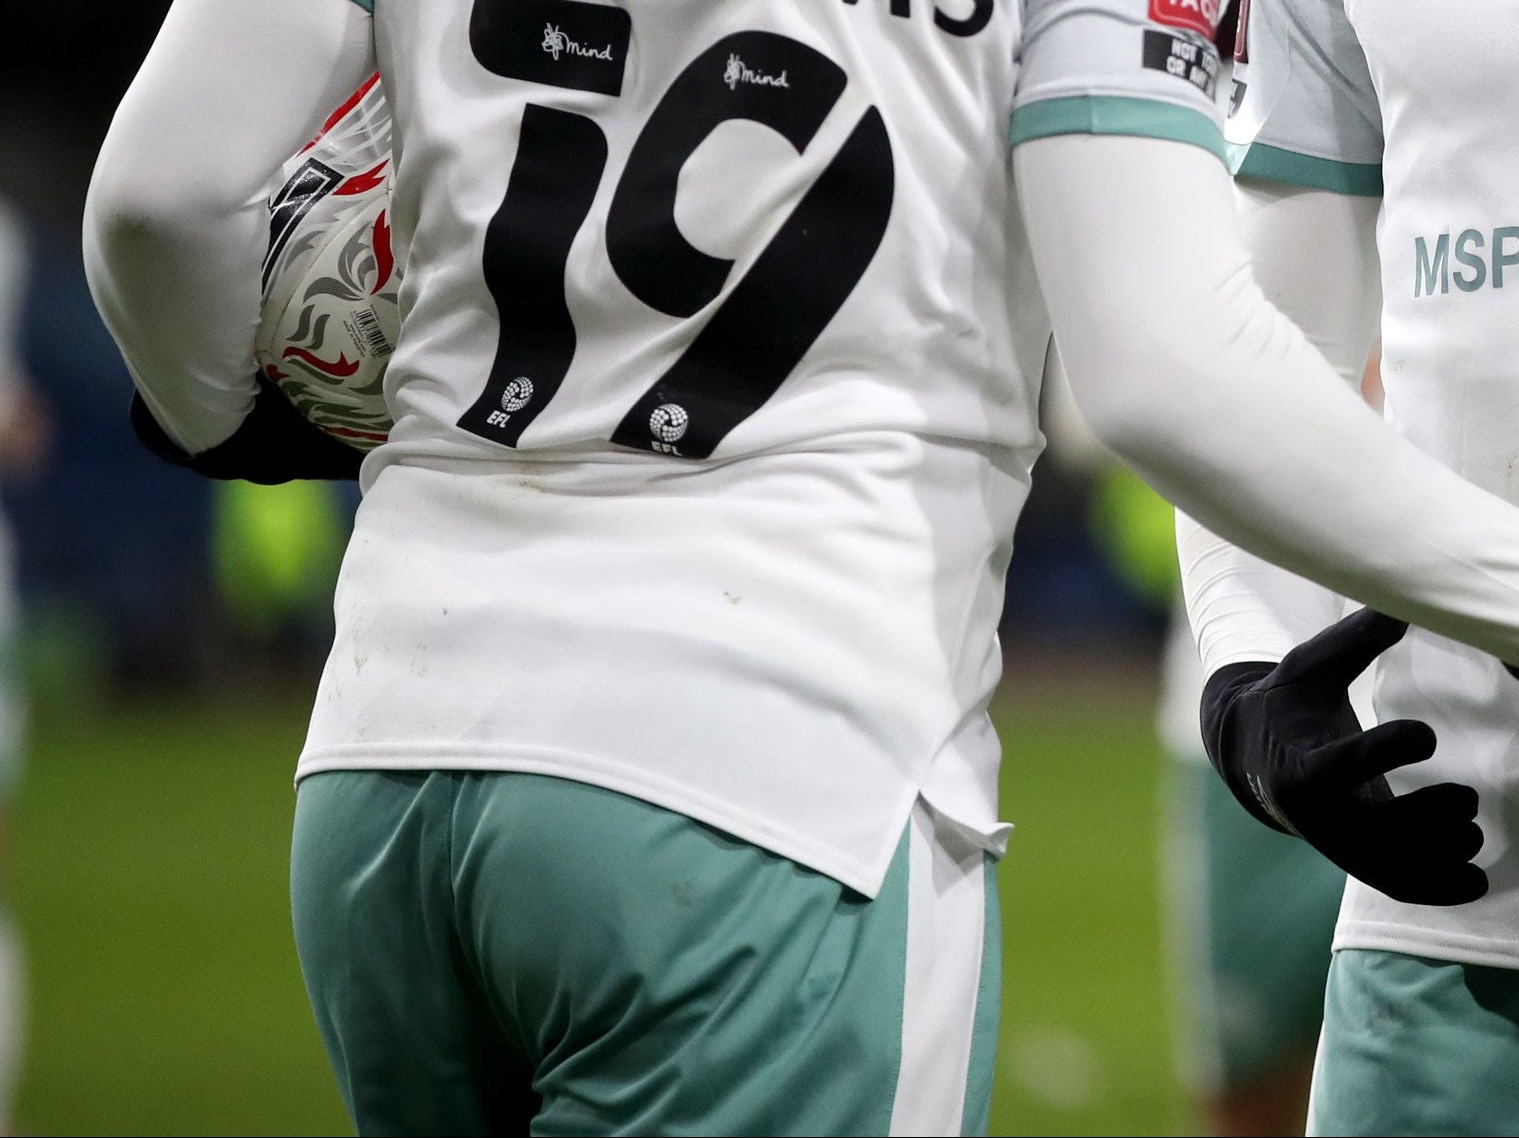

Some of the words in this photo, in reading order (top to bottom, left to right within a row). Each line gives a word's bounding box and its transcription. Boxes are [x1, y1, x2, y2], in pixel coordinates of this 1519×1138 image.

[1172, 38, 1198, 63] NOT
[1166, 55, 1186, 77] OR
[486, 409, 511, 428] EFL
[651, 441, 683, 457] EFL
